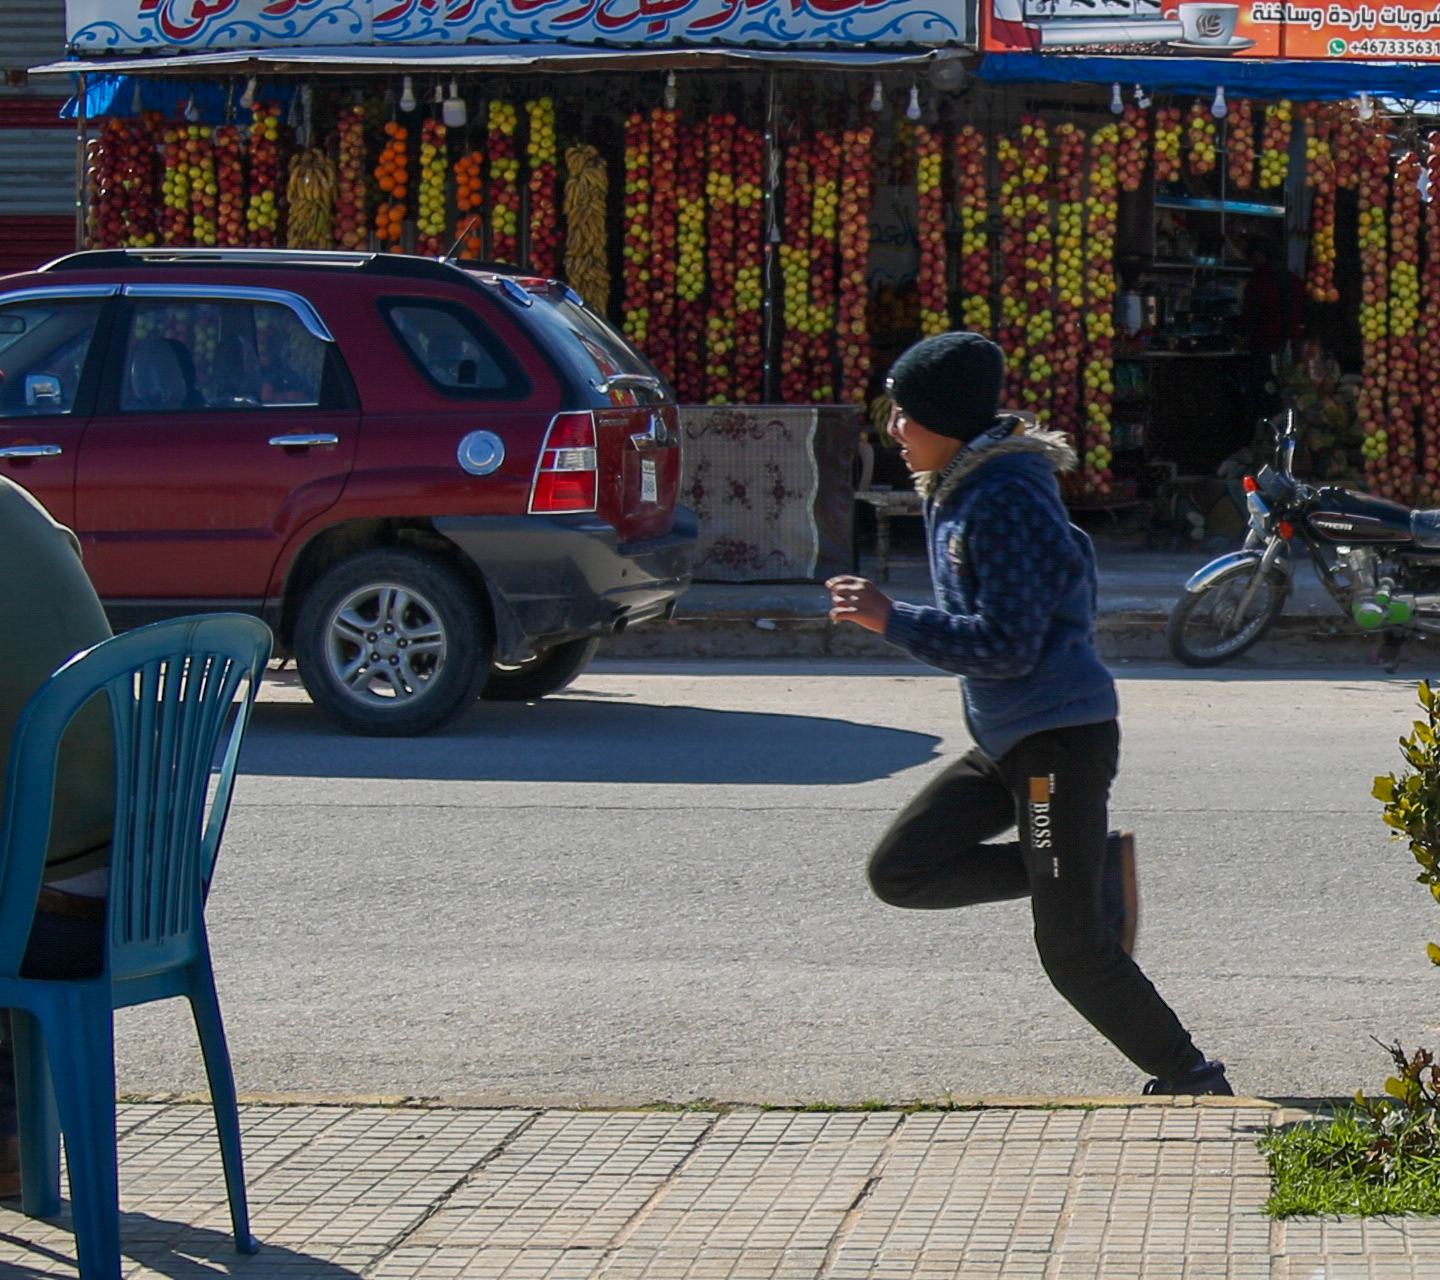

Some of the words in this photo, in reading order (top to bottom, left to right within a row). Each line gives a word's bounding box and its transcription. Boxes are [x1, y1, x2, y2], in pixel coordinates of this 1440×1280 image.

[1252, 3, 1323, 29] وساخنة
[1328, 4, 1374, 31] باردة
[1034, 802, 1052, 849] BOSS
